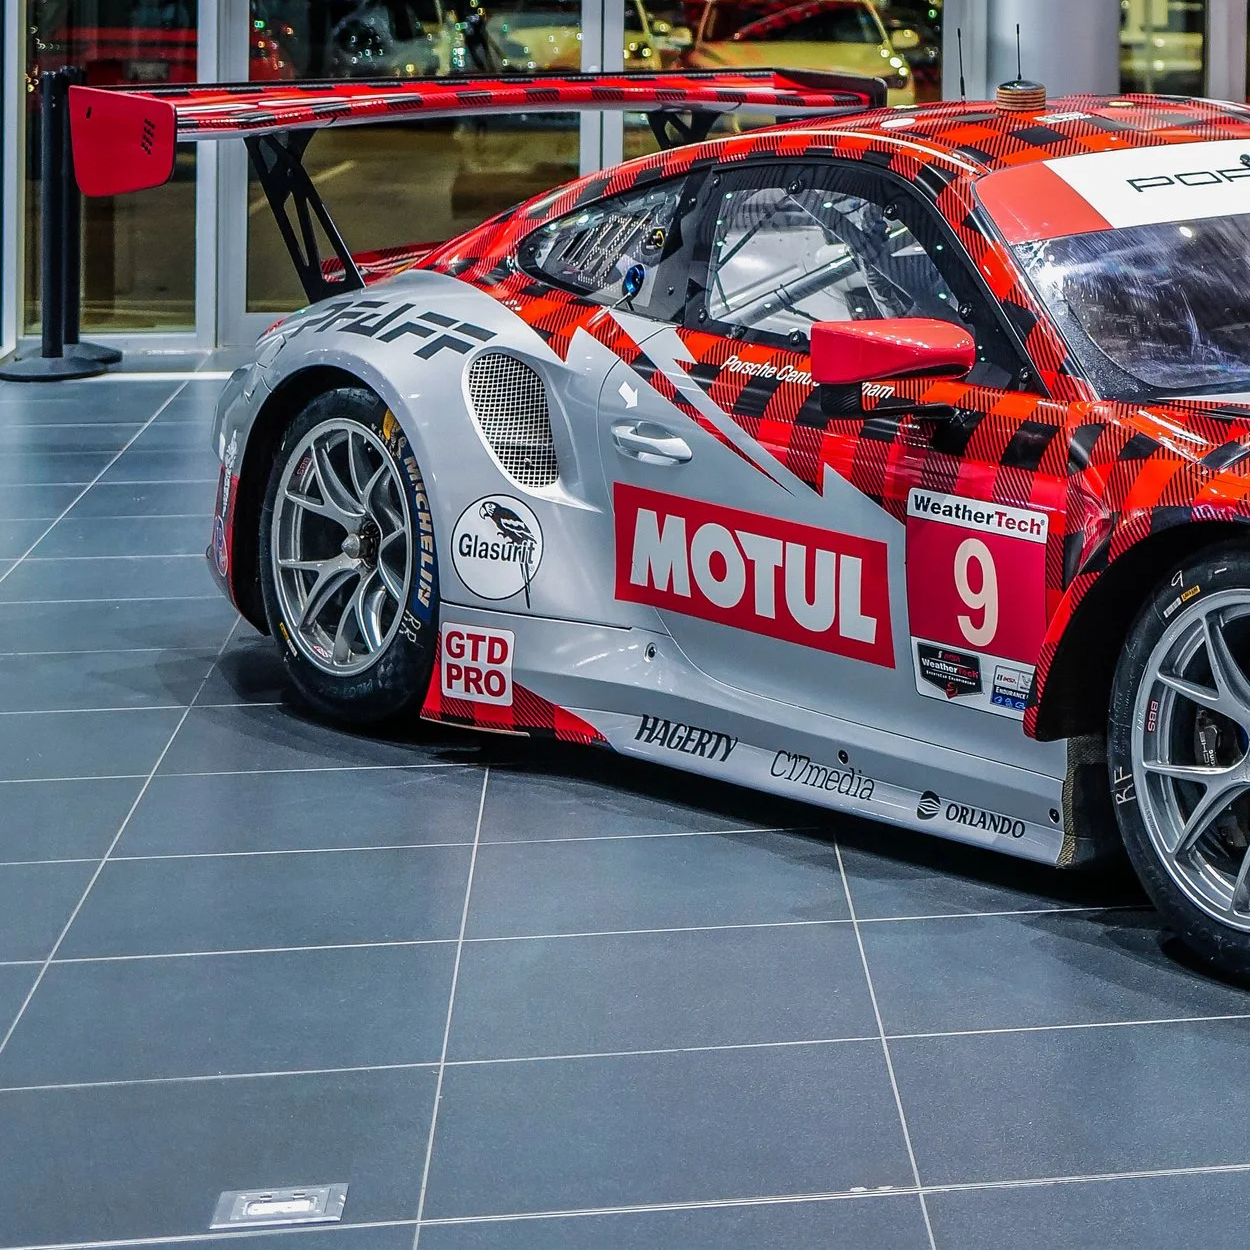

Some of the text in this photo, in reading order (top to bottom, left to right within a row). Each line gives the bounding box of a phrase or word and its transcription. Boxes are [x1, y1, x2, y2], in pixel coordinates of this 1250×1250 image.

[289, 300, 498, 360] PFAFF
[720, 355, 777, 378] Porsche
[403, 456, 433, 609] MICHELIN
[913, 494, 1042, 536] WeatherTech
[458, 533, 536, 565] Glasurit
[630, 508, 878, 645] MOTUL
[954, 537, 998, 646] 9
[445, 630, 509, 665] GTD
[446, 662, 507, 698] PRO
[1147, 700, 1159, 732] BBS
[635, 714, 738, 763] HAGERTY
[769, 749, 876, 802] C17media
[944, 802, 1026, 838] ORLANDO
